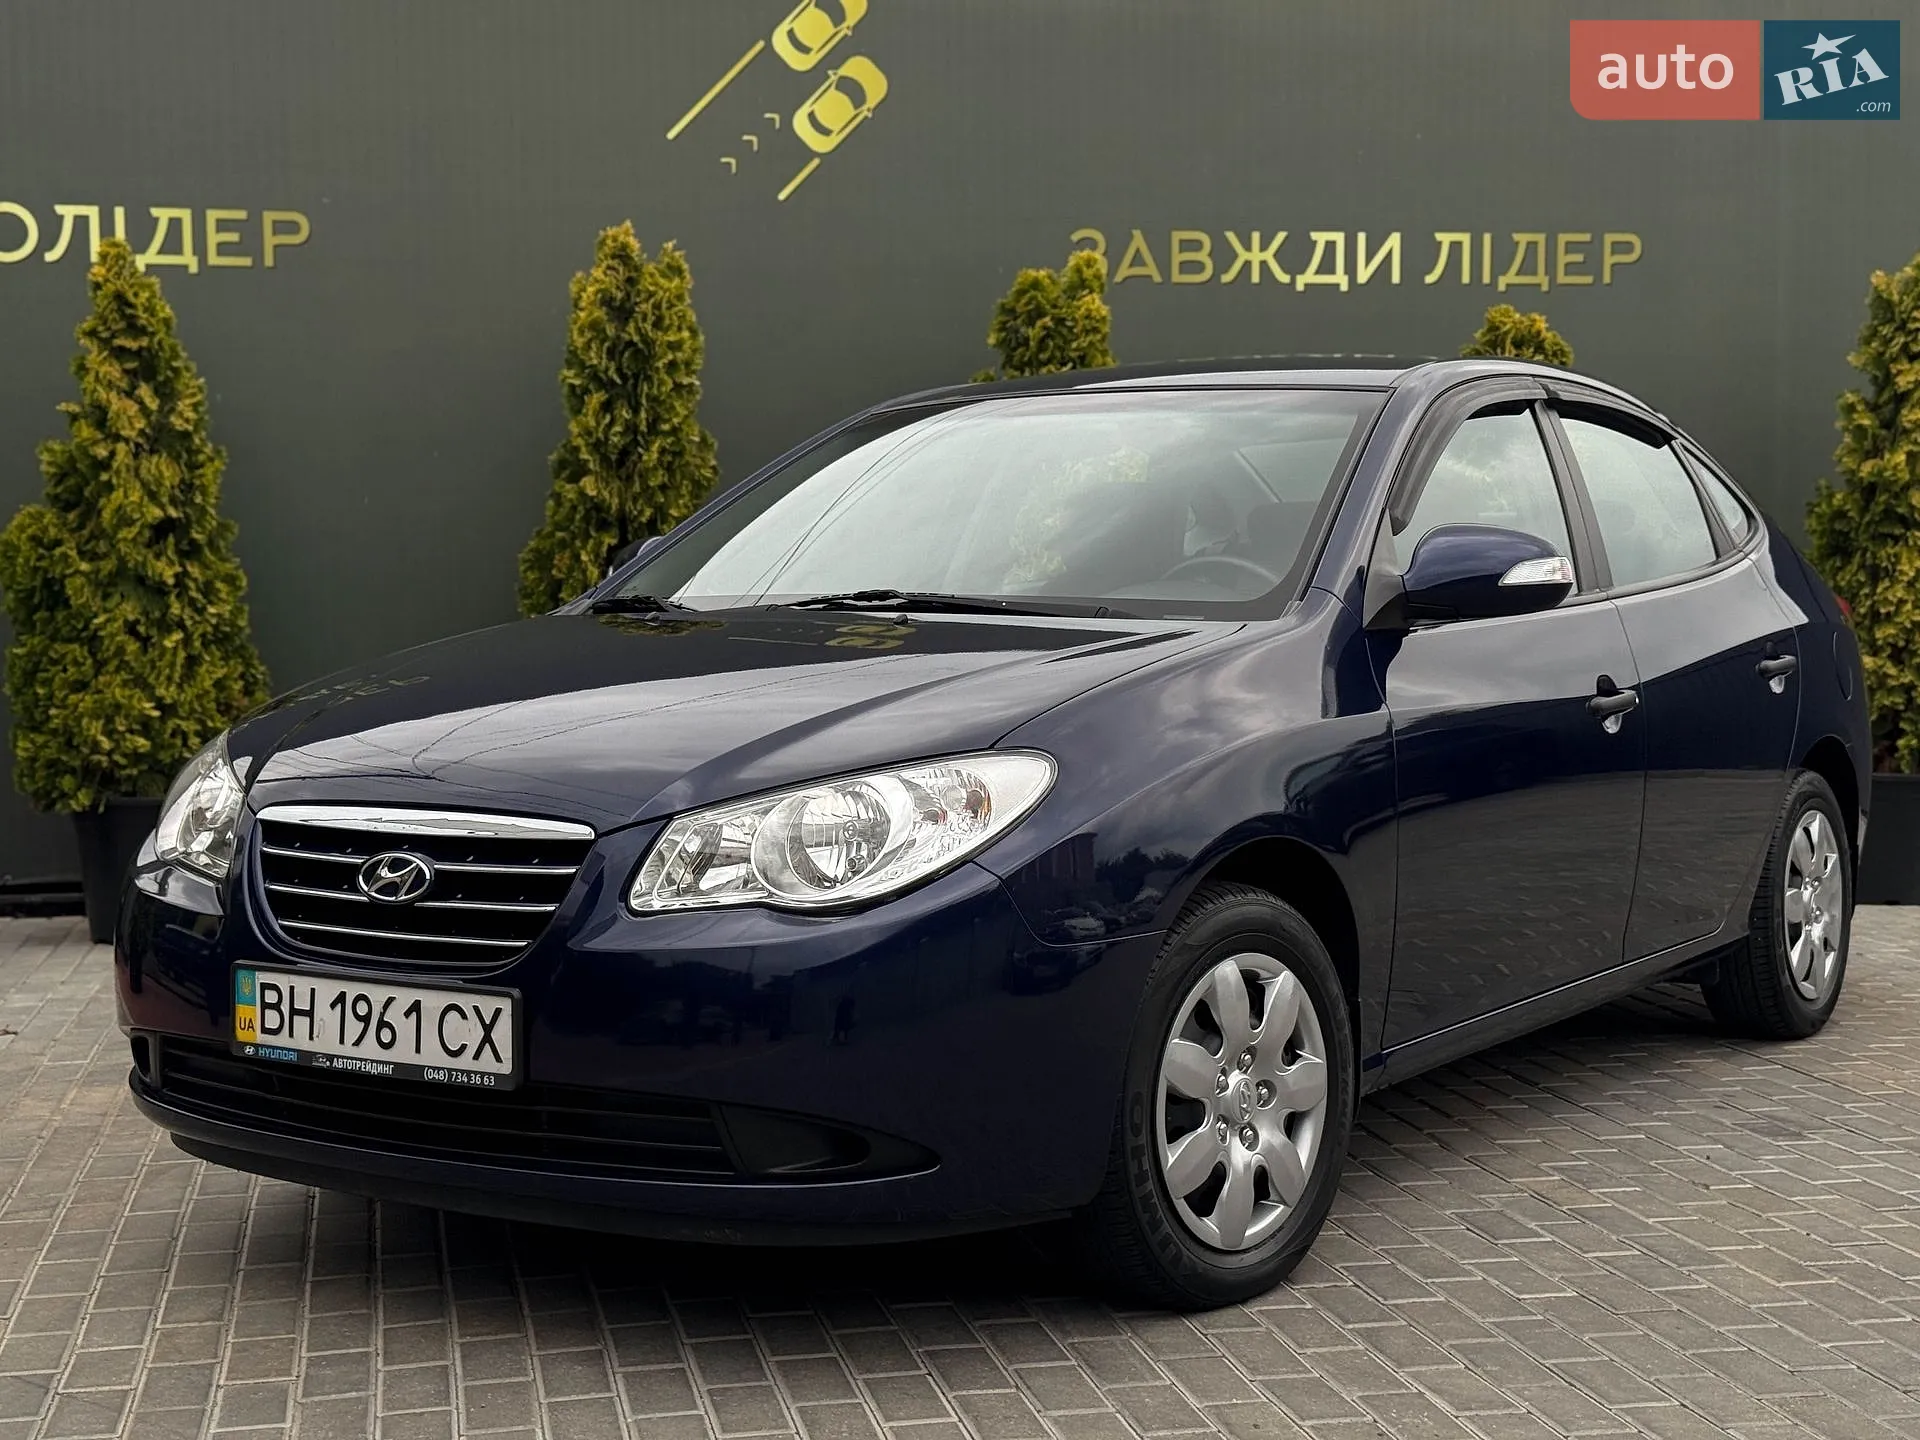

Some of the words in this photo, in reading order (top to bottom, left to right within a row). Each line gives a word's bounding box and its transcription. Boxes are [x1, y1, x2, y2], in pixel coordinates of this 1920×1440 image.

[1069, 228, 1401, 291] ЗАВЖДИ
[1424, 231, 1642, 291] ЛІДЕР
[239, 1017, 255, 1032] UA
[330, 990, 423, 1054] 1961
[258, 1046, 297, 1061] HYUNDAI
[332, 1056, 395, 1076] АВТОТРЕЙДИНГ
[424, 1066, 448, 1083] (048)
[451, 1071, 468, 1083] 734
[469, 1074, 482, 1085] 36
[483, 1075, 495, 1086] 63
